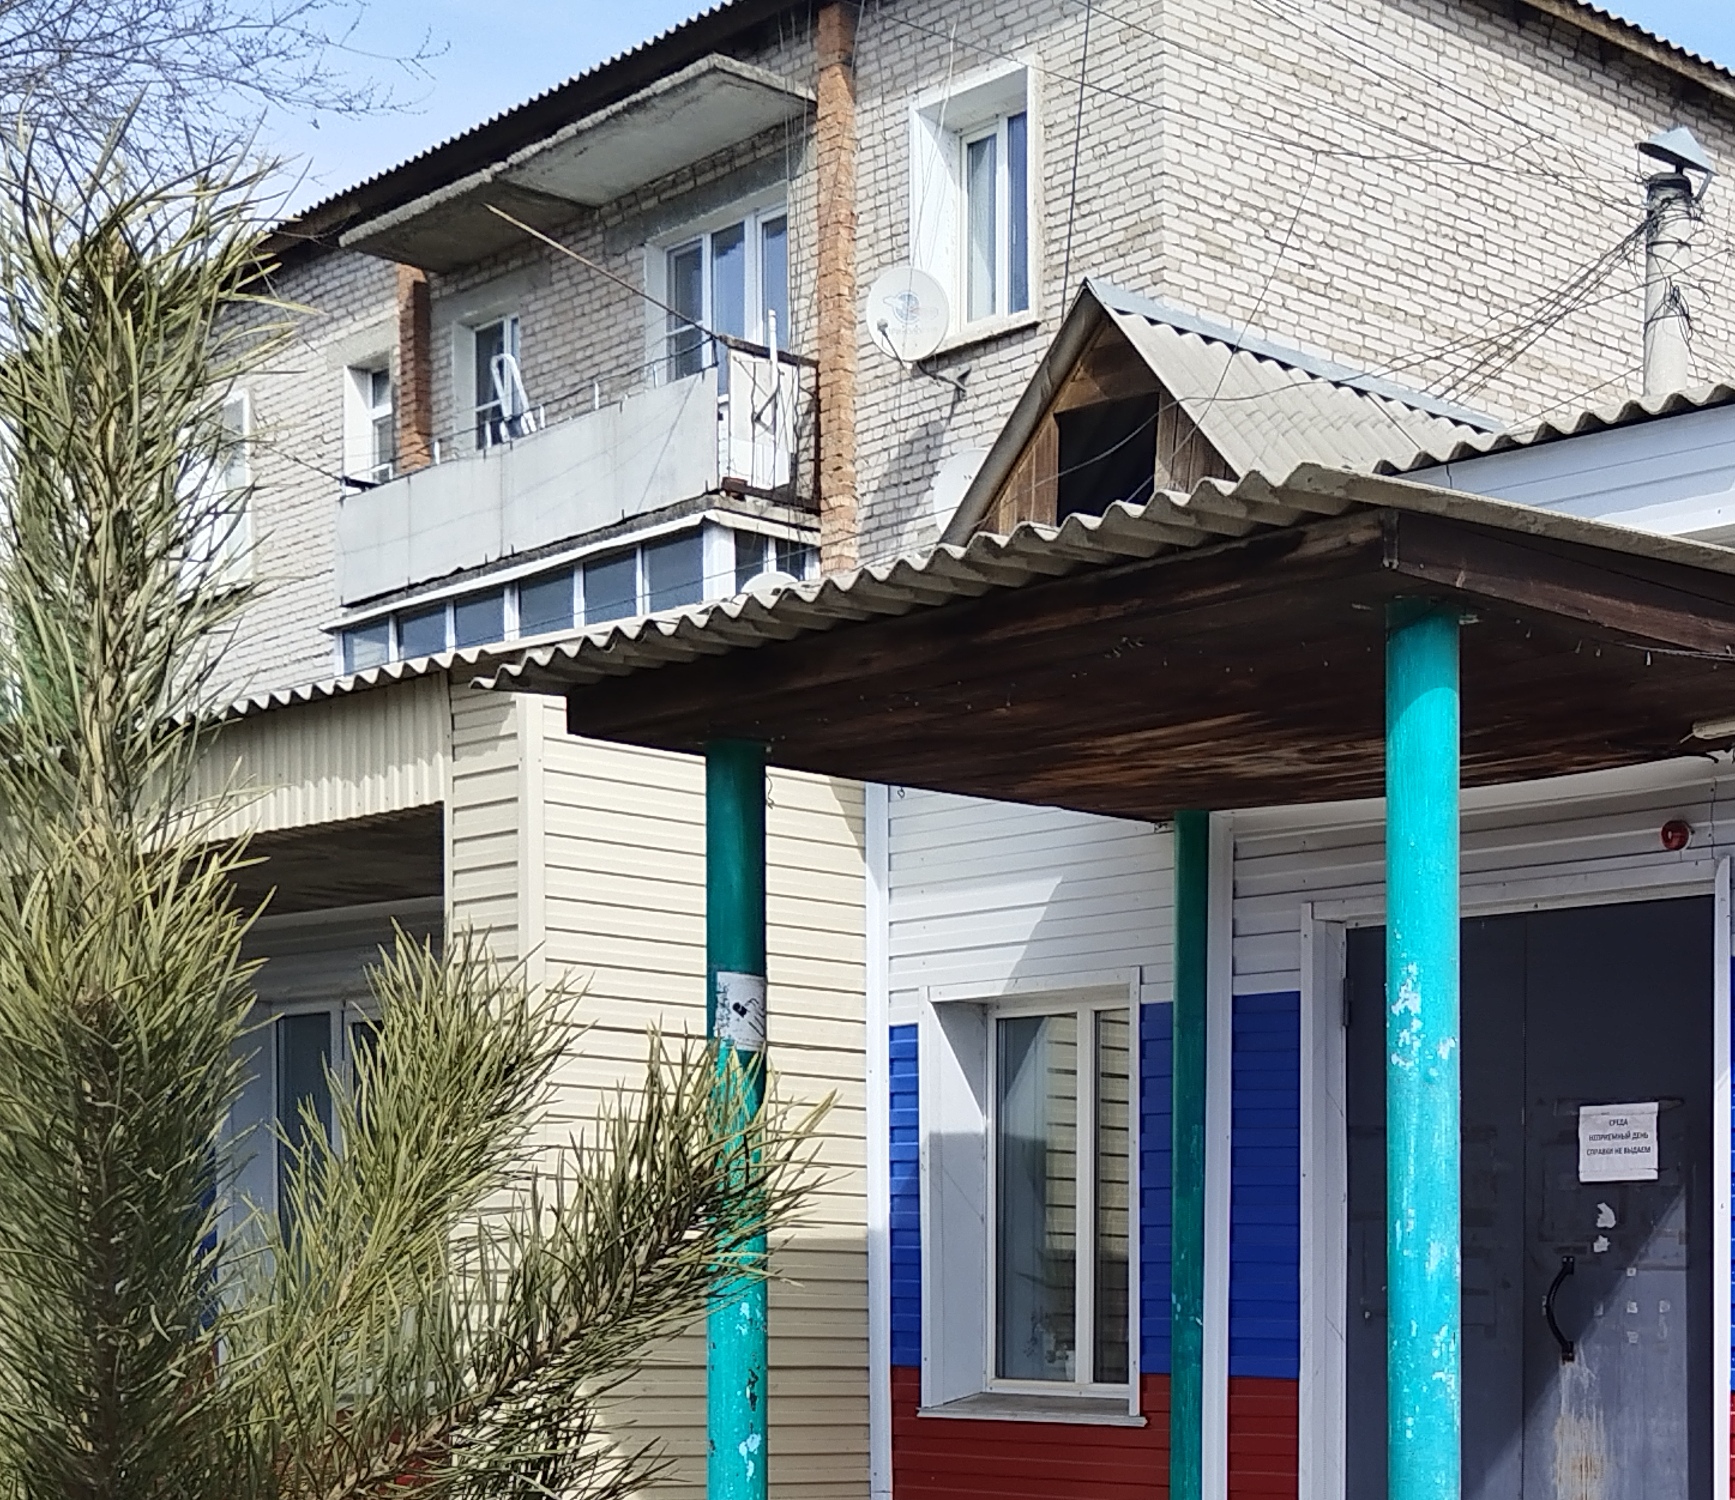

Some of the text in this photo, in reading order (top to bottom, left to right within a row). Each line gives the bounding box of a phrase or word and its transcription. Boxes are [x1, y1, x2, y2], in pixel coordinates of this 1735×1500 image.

[1609, 1118, 1628, 1126] СРЕДА
[1632, 1131, 1649, 1140] ДЕНЬ
[1587, 1145, 1651, 1156] СПРАВКИ НЕ ВЫДАЕМ
